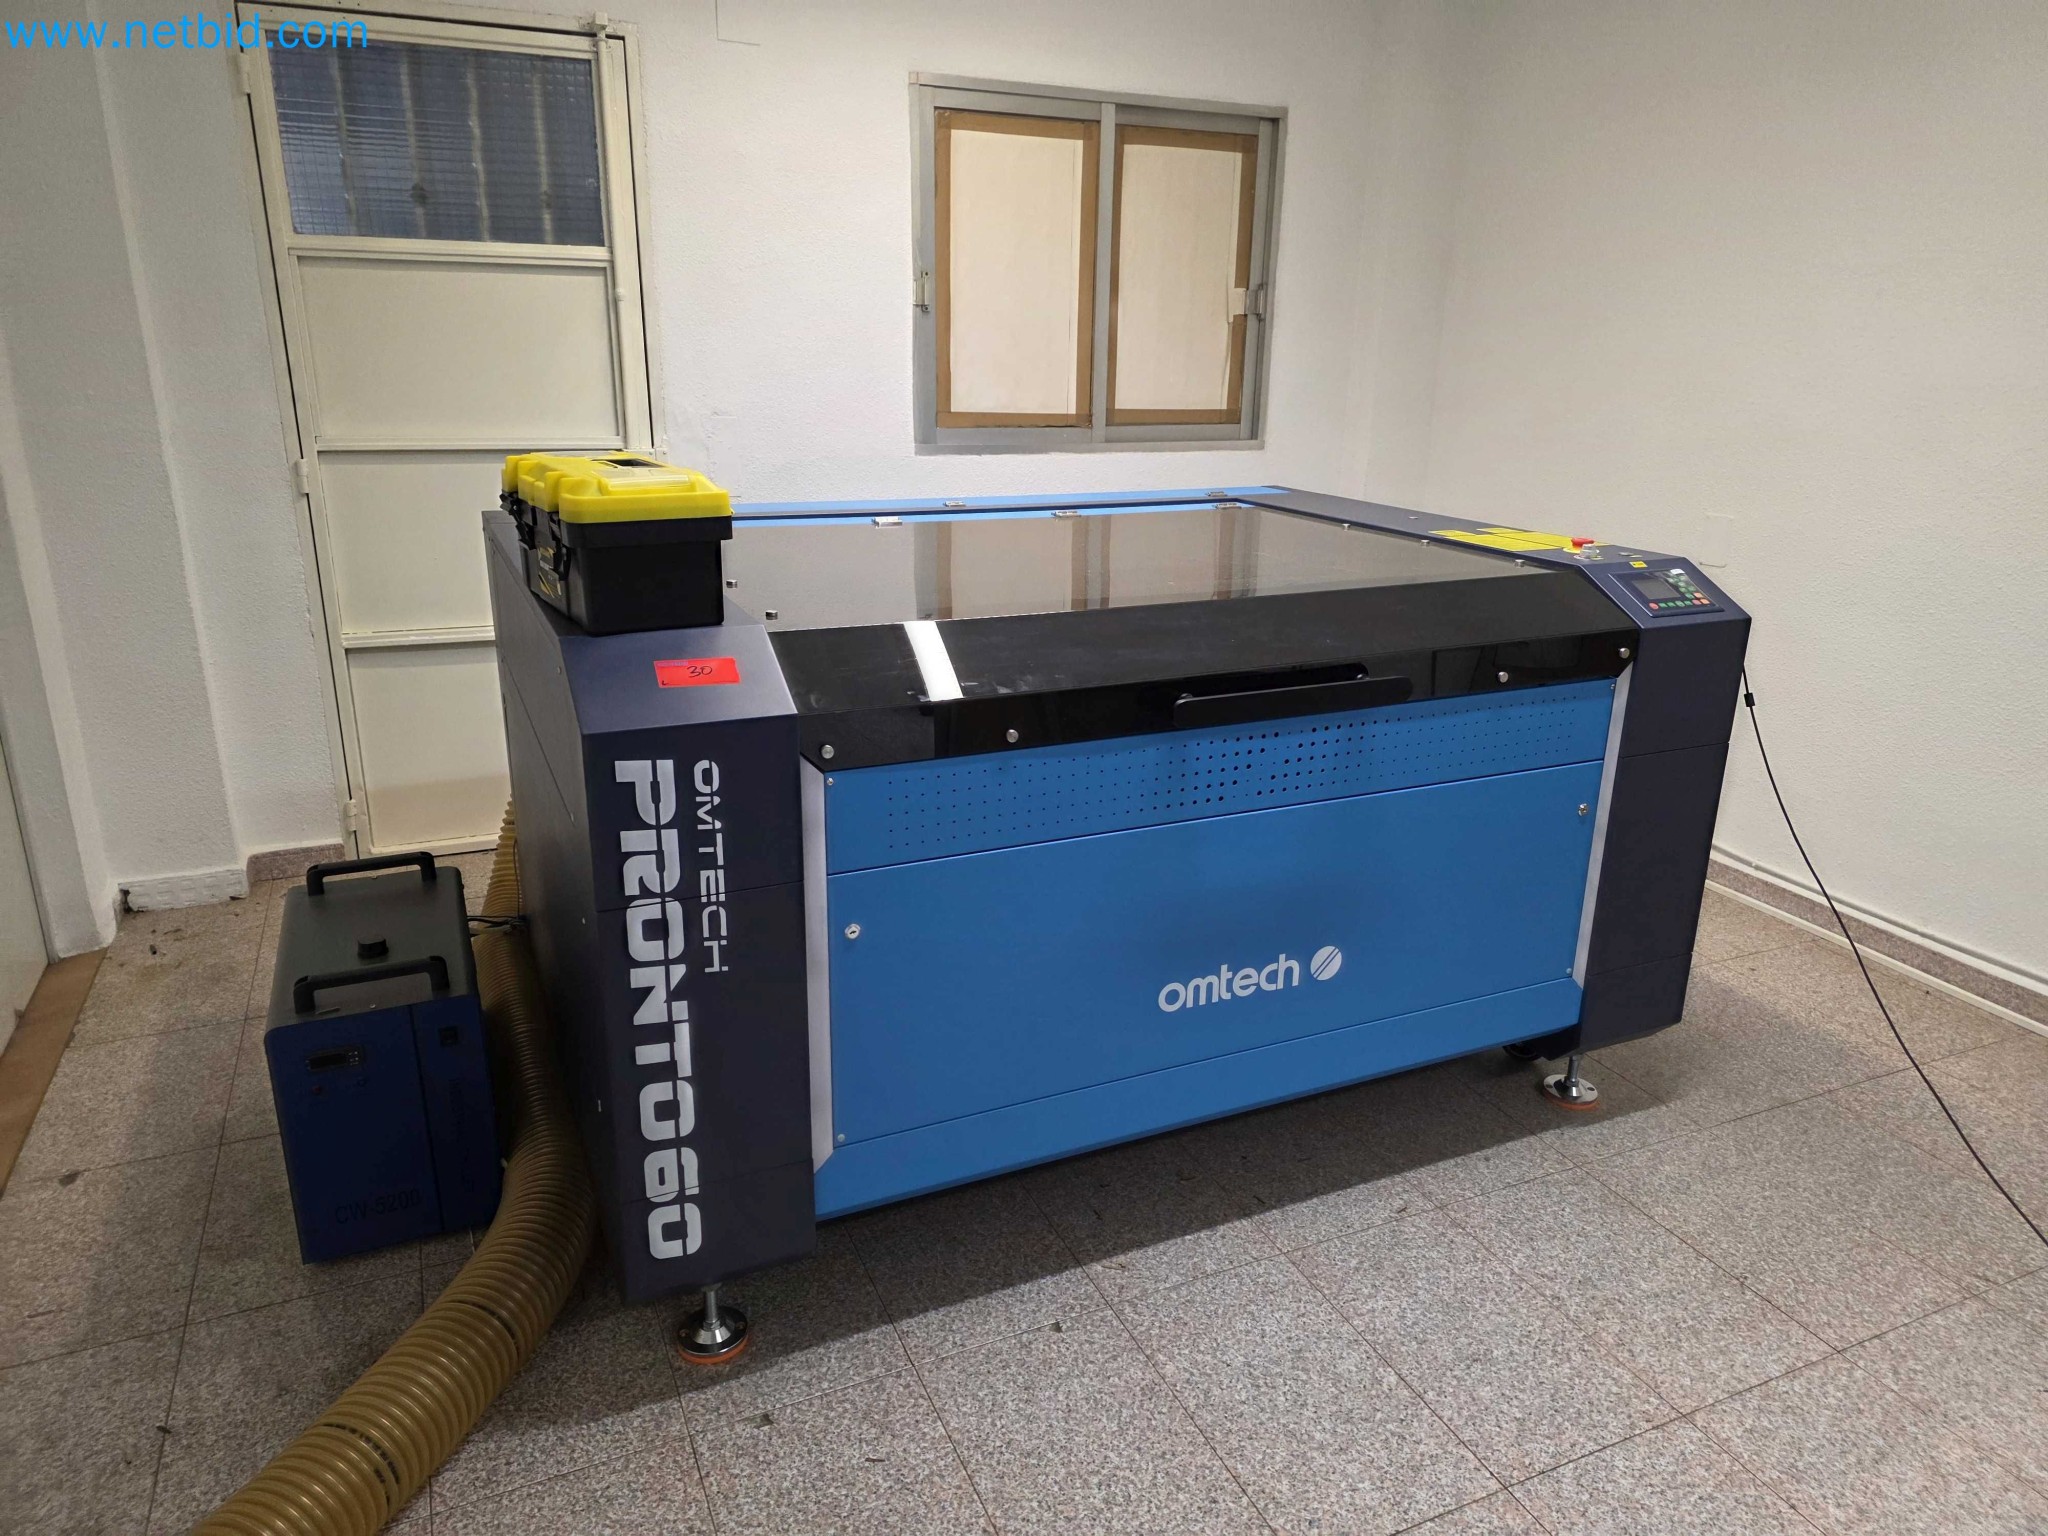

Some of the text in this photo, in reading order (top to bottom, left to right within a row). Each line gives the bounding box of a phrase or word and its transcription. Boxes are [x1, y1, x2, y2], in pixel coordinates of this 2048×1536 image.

[686, 665, 713, 678] 30
[693, 759, 729, 973] OMTECH
[1157, 953, 1300, 1013] omtech
[334, 1187, 422, 1225] CW-5200
